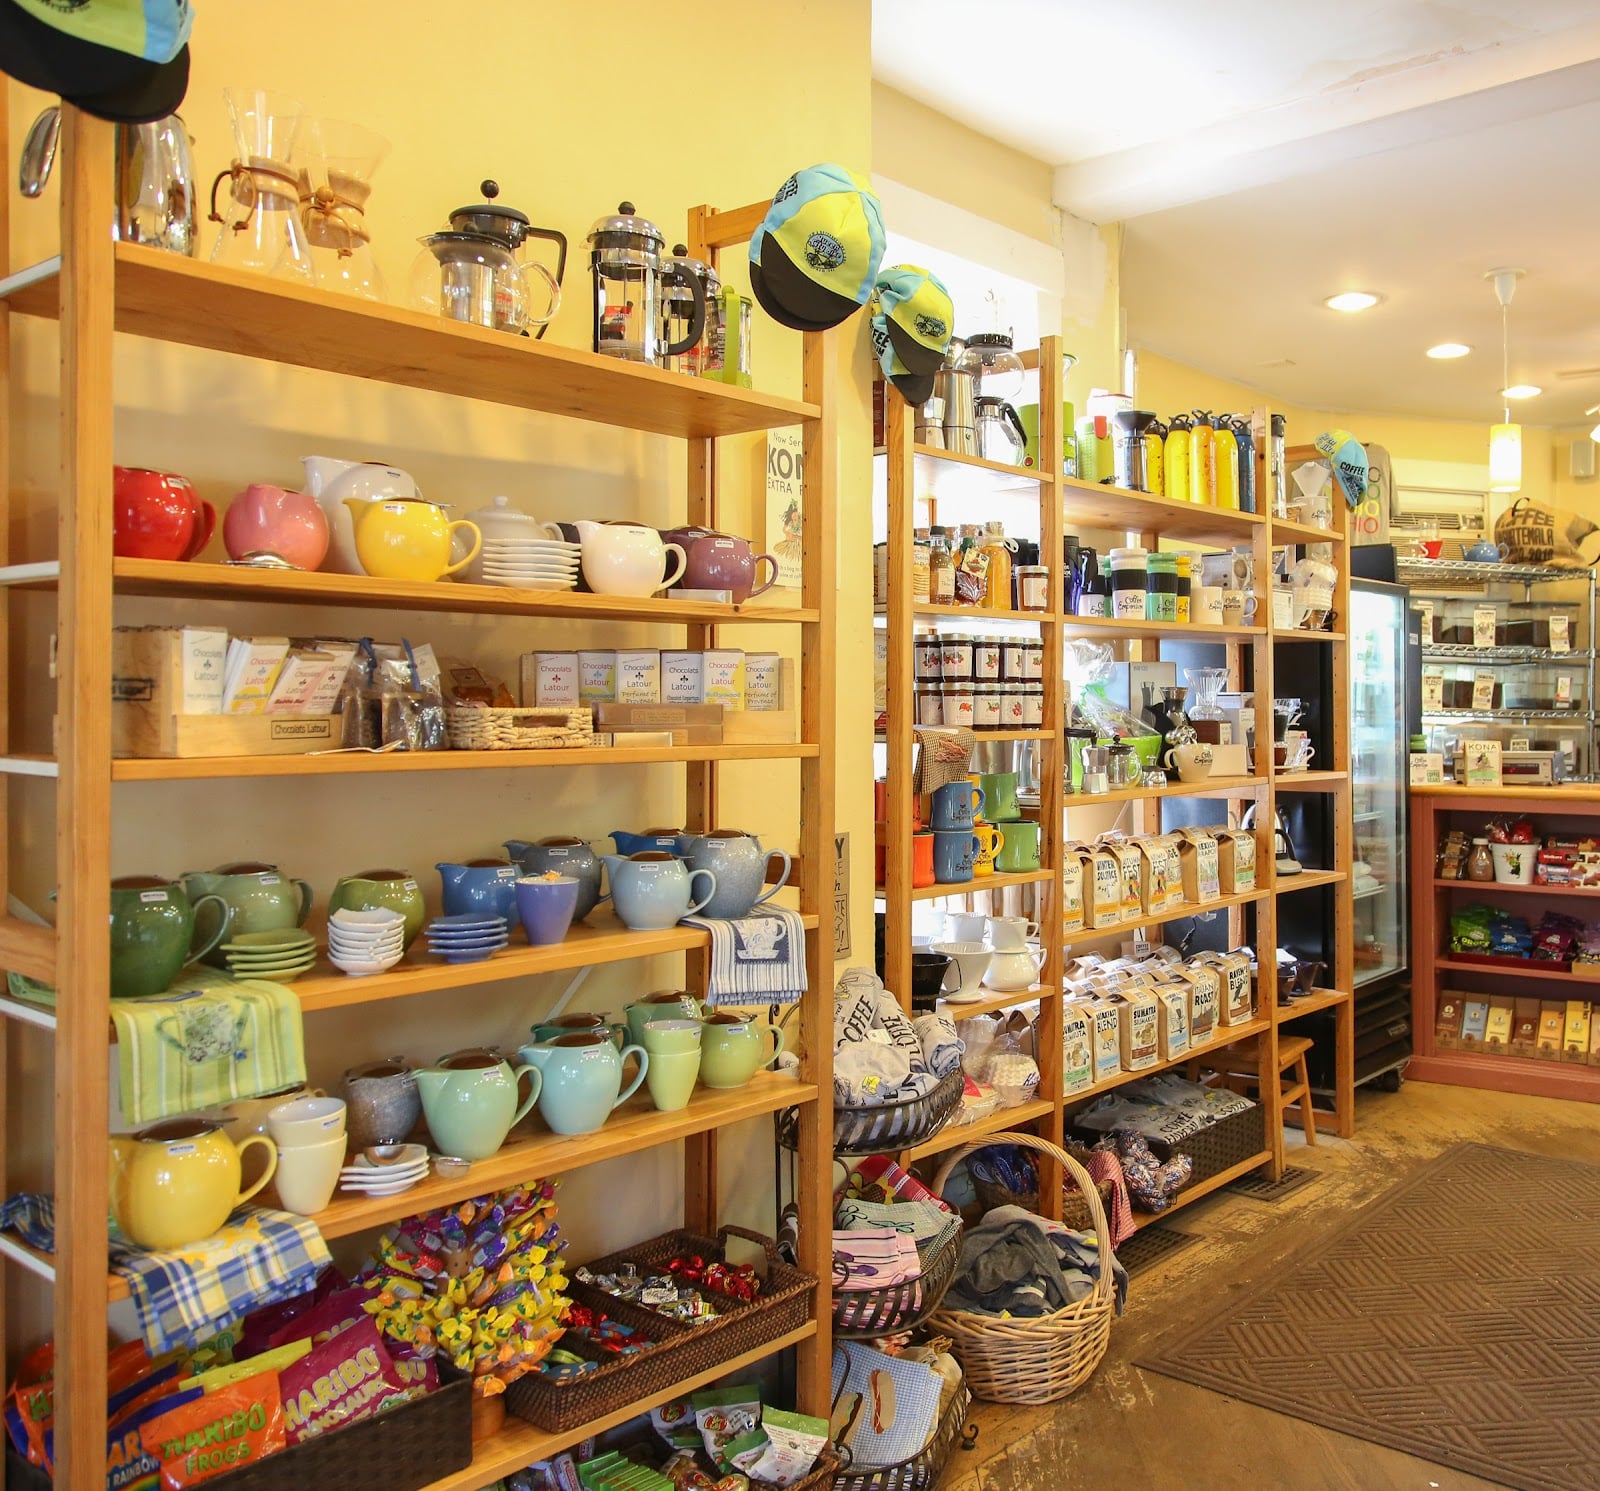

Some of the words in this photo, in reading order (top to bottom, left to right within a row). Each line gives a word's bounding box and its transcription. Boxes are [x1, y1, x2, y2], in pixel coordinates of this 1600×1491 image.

[773, 432, 787, 443] Now
[1340, 461, 1365, 476] COFFEE
[768, 477, 792, 494] EXTRA
[1124, 594, 1142, 603] Coffee
[1118, 601, 1143, 613] Emporium
[582, 662, 613, 670] Chocolats
[669, 666, 699, 674] Chocolats
[708, 661, 739, 669] Chocolats
[745, 665, 775, 673] Chocolats
[584, 678, 610, 686] Latour
[626, 680, 653, 688] Latour
[671, 683, 696, 691] Latour
[711, 678, 736, 686] Latour
[748, 681, 773, 689] Latour
[274, 724, 306, 734] Chocolats
[307, 722, 328, 733] Latour
[1197, 840, 1217, 851] MEXICO
[1096, 859, 1116, 871] WINTER
[1097, 870, 1118, 881] SOLSTICE
[1122, 863, 1141, 881] FEST
[1229, 976, 1249, 990] BLEND
[1194, 991, 1214, 1006] ROAST
[1133, 1005, 1156, 1019] SUMATRA
[1097, 1017, 1117, 1033] BLEND
[283, 1346, 381, 1432] HARIBO
[161, 1402, 266, 1459] HARIBO
[185, 1441, 251, 1476] FROGS
